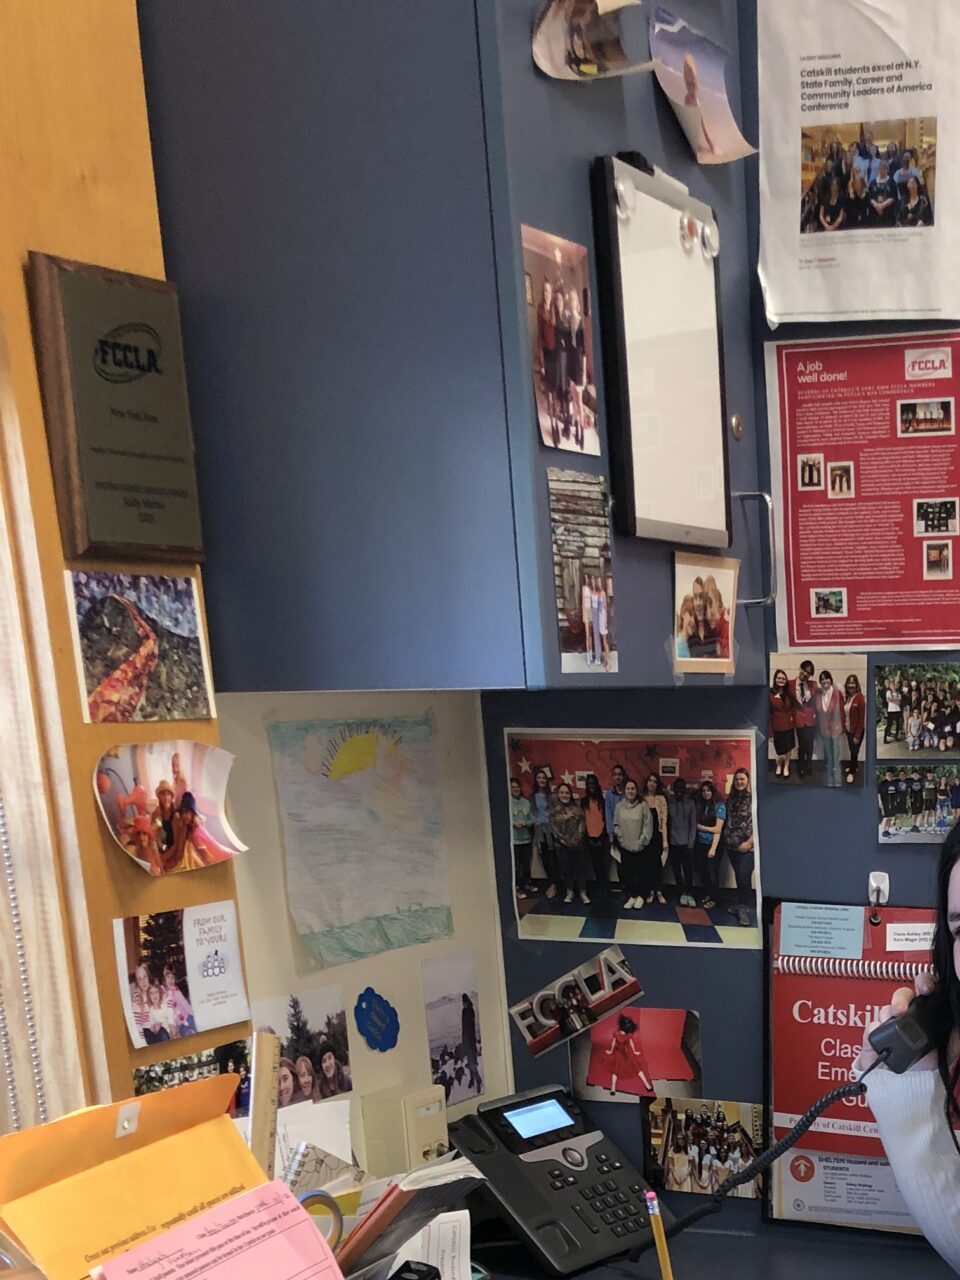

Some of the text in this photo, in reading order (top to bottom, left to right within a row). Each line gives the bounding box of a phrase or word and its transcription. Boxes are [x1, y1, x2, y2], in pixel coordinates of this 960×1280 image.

[800, 60, 921, 78] Catskill students excel at N.Y.
[800, 74, 902, 90] State Family, Career and
[800, 82, 932, 101] Community Leaders of America
[800, 102, 849, 112] Conference
[98, 338, 162, 374] FCCLA
[797, 361, 822, 372] A job
[911, 360, 946, 371] FCCLA
[798, 371, 848, 384] well done!
[194, 914, 226, 928] FROM OUR
[199, 925, 222, 936] FAMILY
[196, 934, 227, 946] TO YOURS
[792, 1000, 883, 1028] Catskil
[821, 1038, 862, 1058] Clas
[818, 1062, 859, 1082] Eme
[842, 1096, 868, 1107] Gu
[789, 1118, 878, 1134] Prty of Catskill Cen
